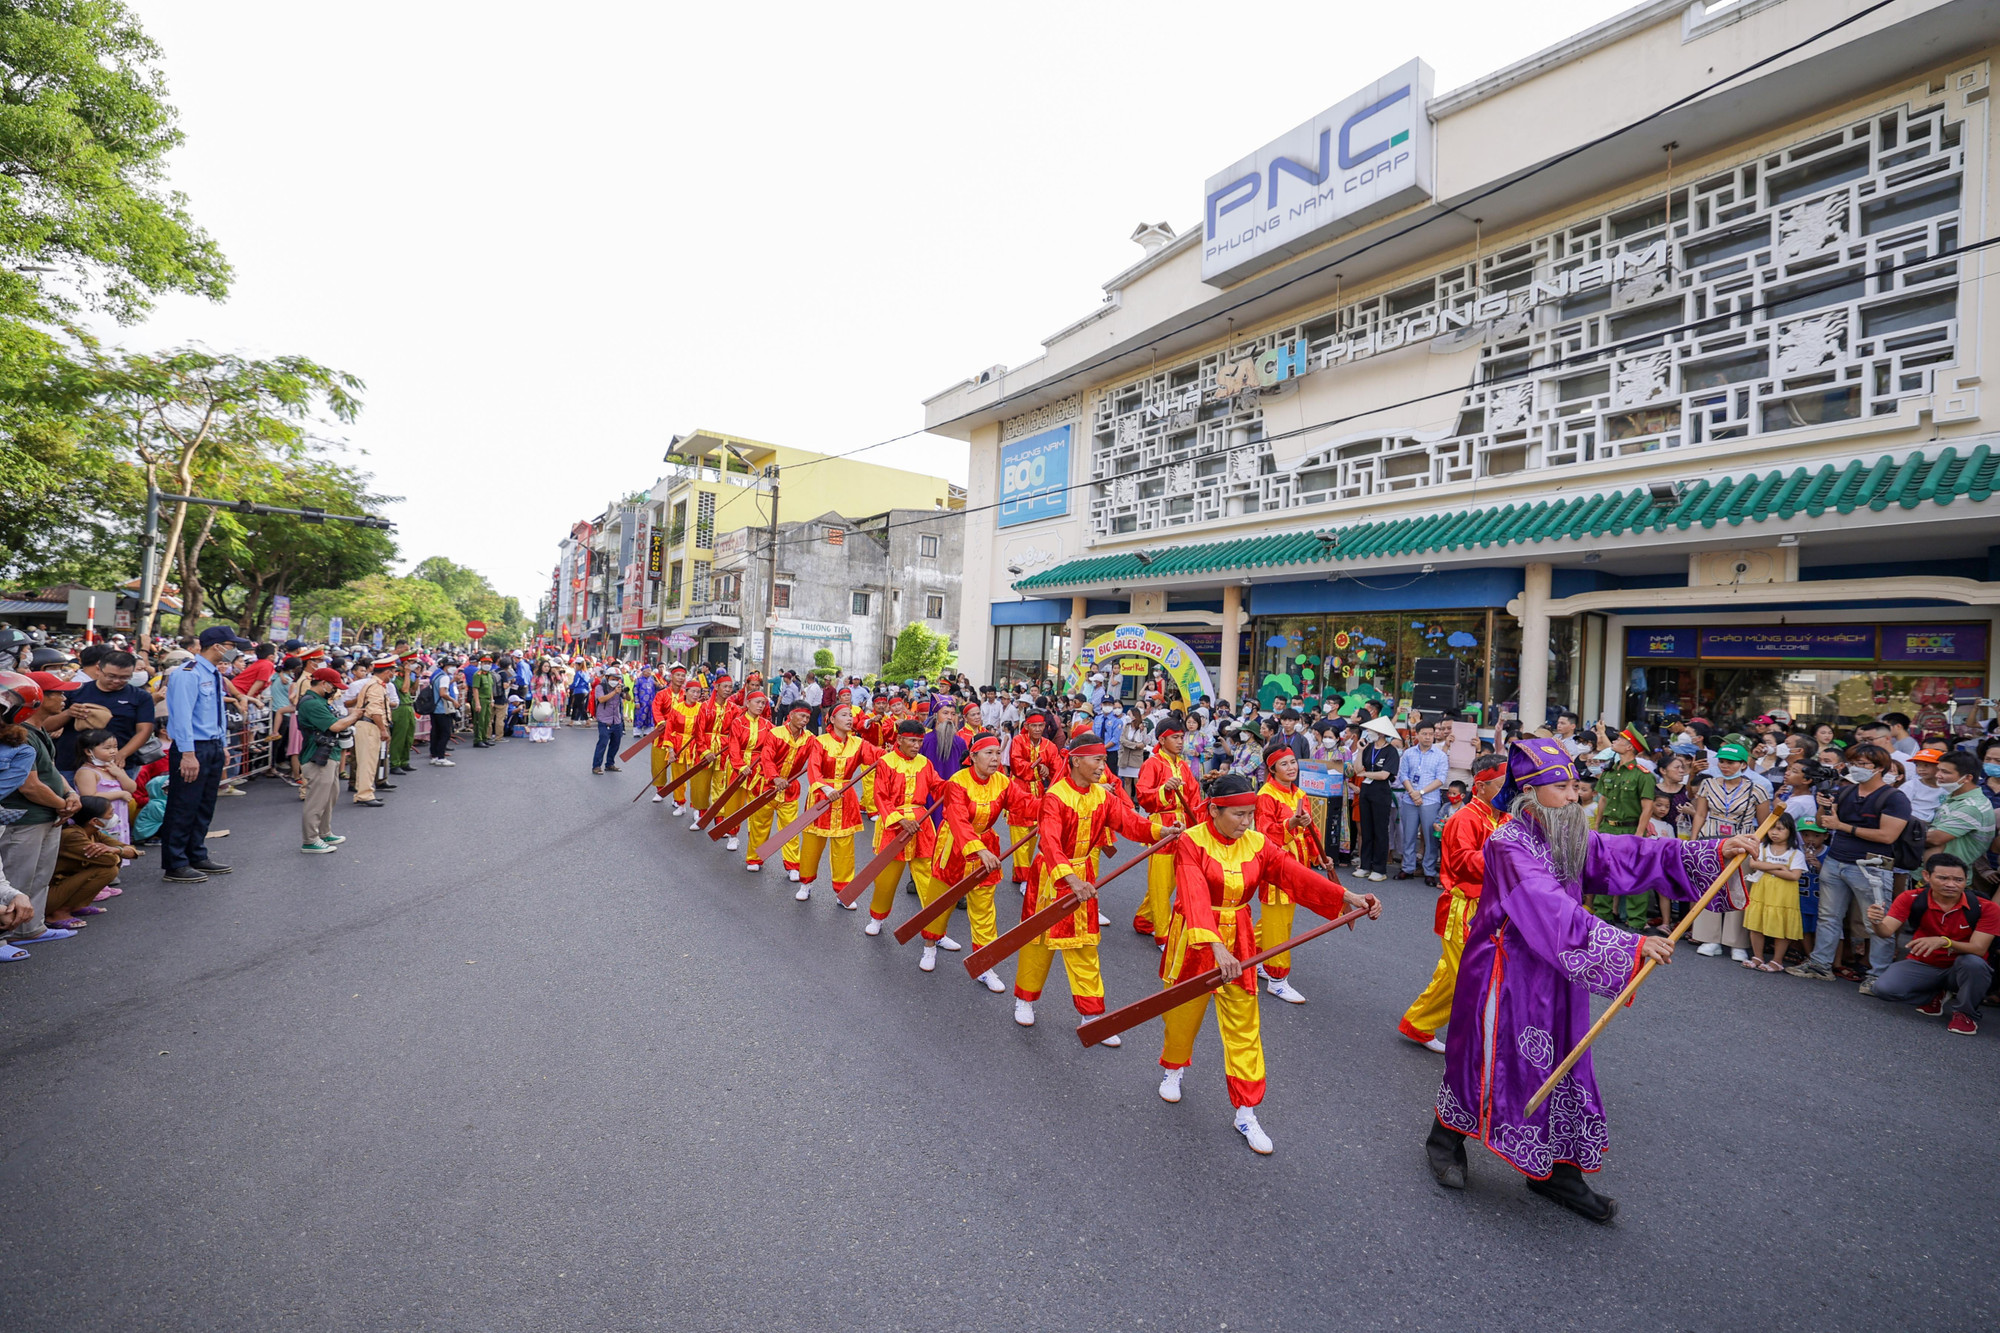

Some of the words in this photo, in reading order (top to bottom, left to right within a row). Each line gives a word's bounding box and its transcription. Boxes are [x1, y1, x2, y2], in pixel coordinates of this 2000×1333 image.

[1206, 83, 1411, 242] PNC
[1206, 214, 1281, 261] PHUONG
[1289, 188, 1334, 220] NAM
[1344, 151, 1410, 193] CORP
[1529, 239, 1668, 307] NAM
[1004, 446, 1042, 466] PHUONG
[1043, 439, 1066, 454] NAM
[1002, 483, 1062, 515] CAFE
[1116, 626, 1145, 638] SUMMER
[1906, 636, 1955, 648] BOOK
[1098, 642, 1111, 656] BIG
[1112, 639, 1137, 651] SALES
[1140, 640, 1163, 657] 2022
